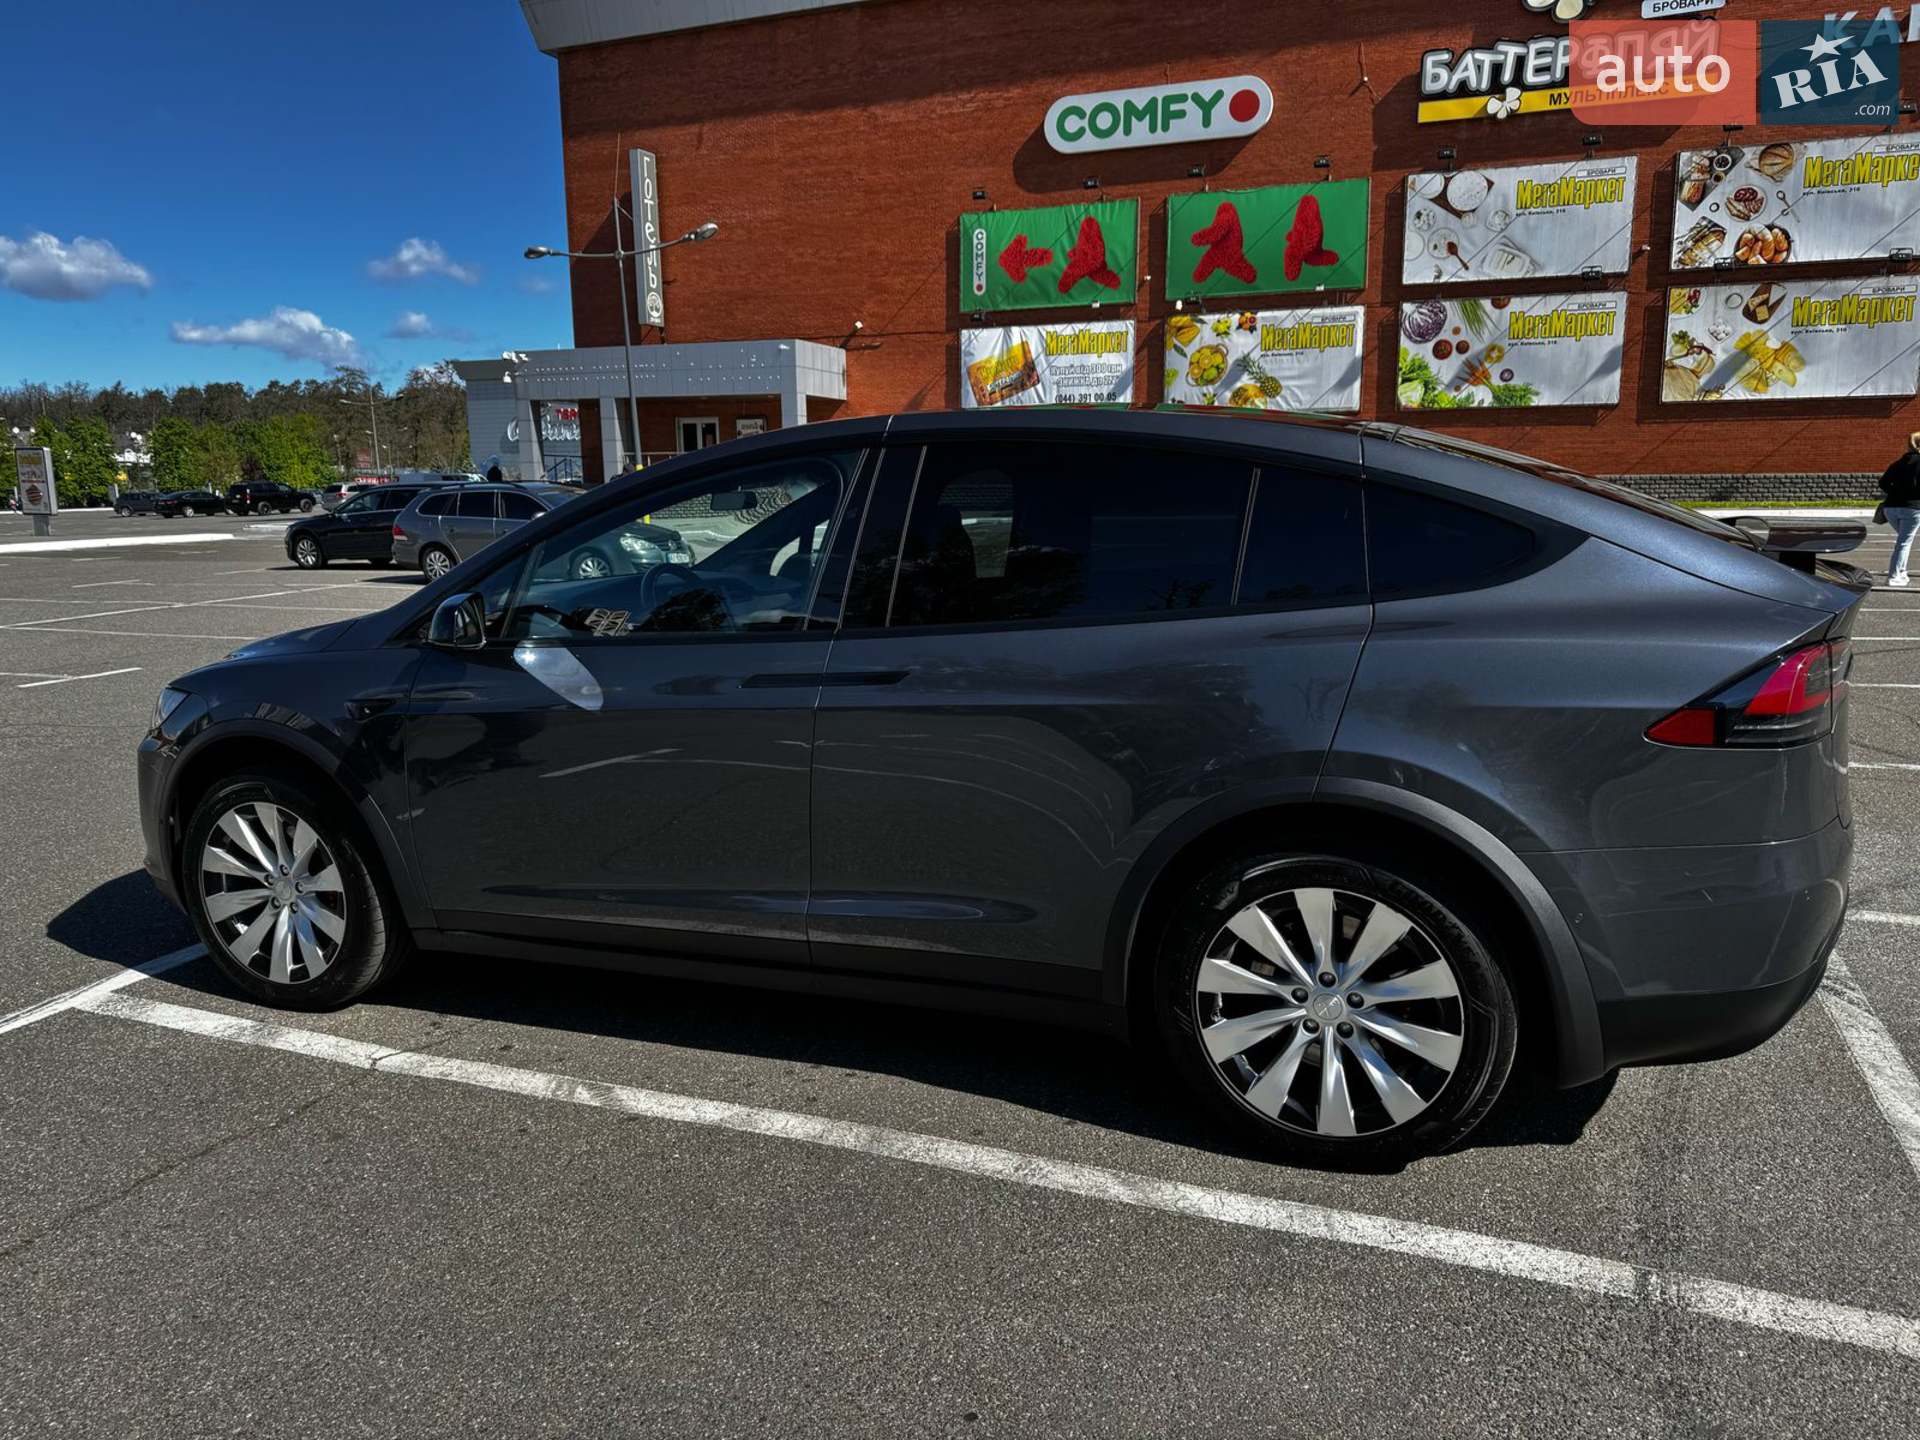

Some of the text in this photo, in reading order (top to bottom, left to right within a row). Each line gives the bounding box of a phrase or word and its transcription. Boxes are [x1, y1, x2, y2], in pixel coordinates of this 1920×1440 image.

[1056, 89, 1224, 142] COMFY
[1516, 176, 1626, 210] МегаМаркет
[975, 231, 984, 281] COMFY
[1508, 309, 1617, 342] МегаМаркет
[1791, 294, 1917, 329] МегаМаркет
[1045, 330, 1129, 358] МегаМаркет
[1260, 322, 1356, 353] МегаМаркет
[1055, 391, 1117, 403] (044) 391 00 05
